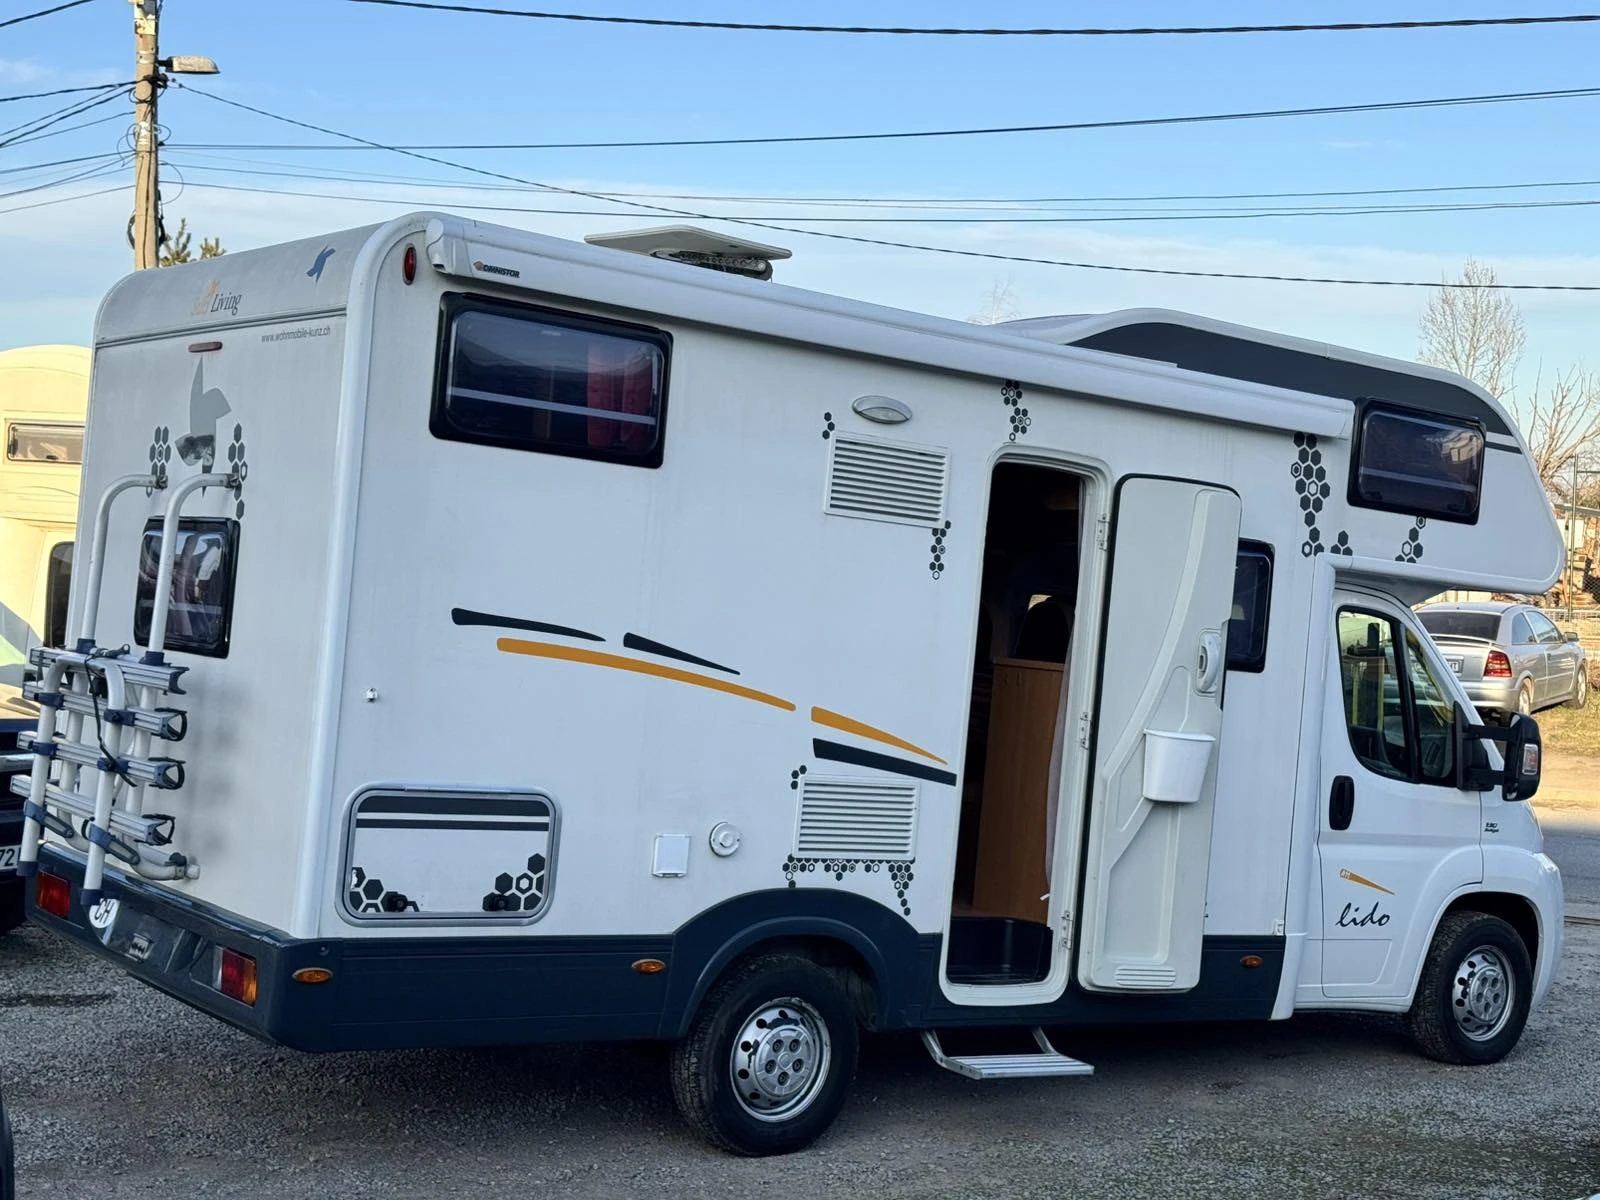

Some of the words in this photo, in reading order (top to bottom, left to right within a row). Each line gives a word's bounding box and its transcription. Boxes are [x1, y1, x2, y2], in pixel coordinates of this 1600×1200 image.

[483, 264, 520, 278] OMNISTOR
[210, 292, 242, 316] Living
[260, 325, 331, 343] www.wohnmobile-kunz.ch
[95, 898, 115, 924] CH
[1335, 901, 1391, 928] lido
